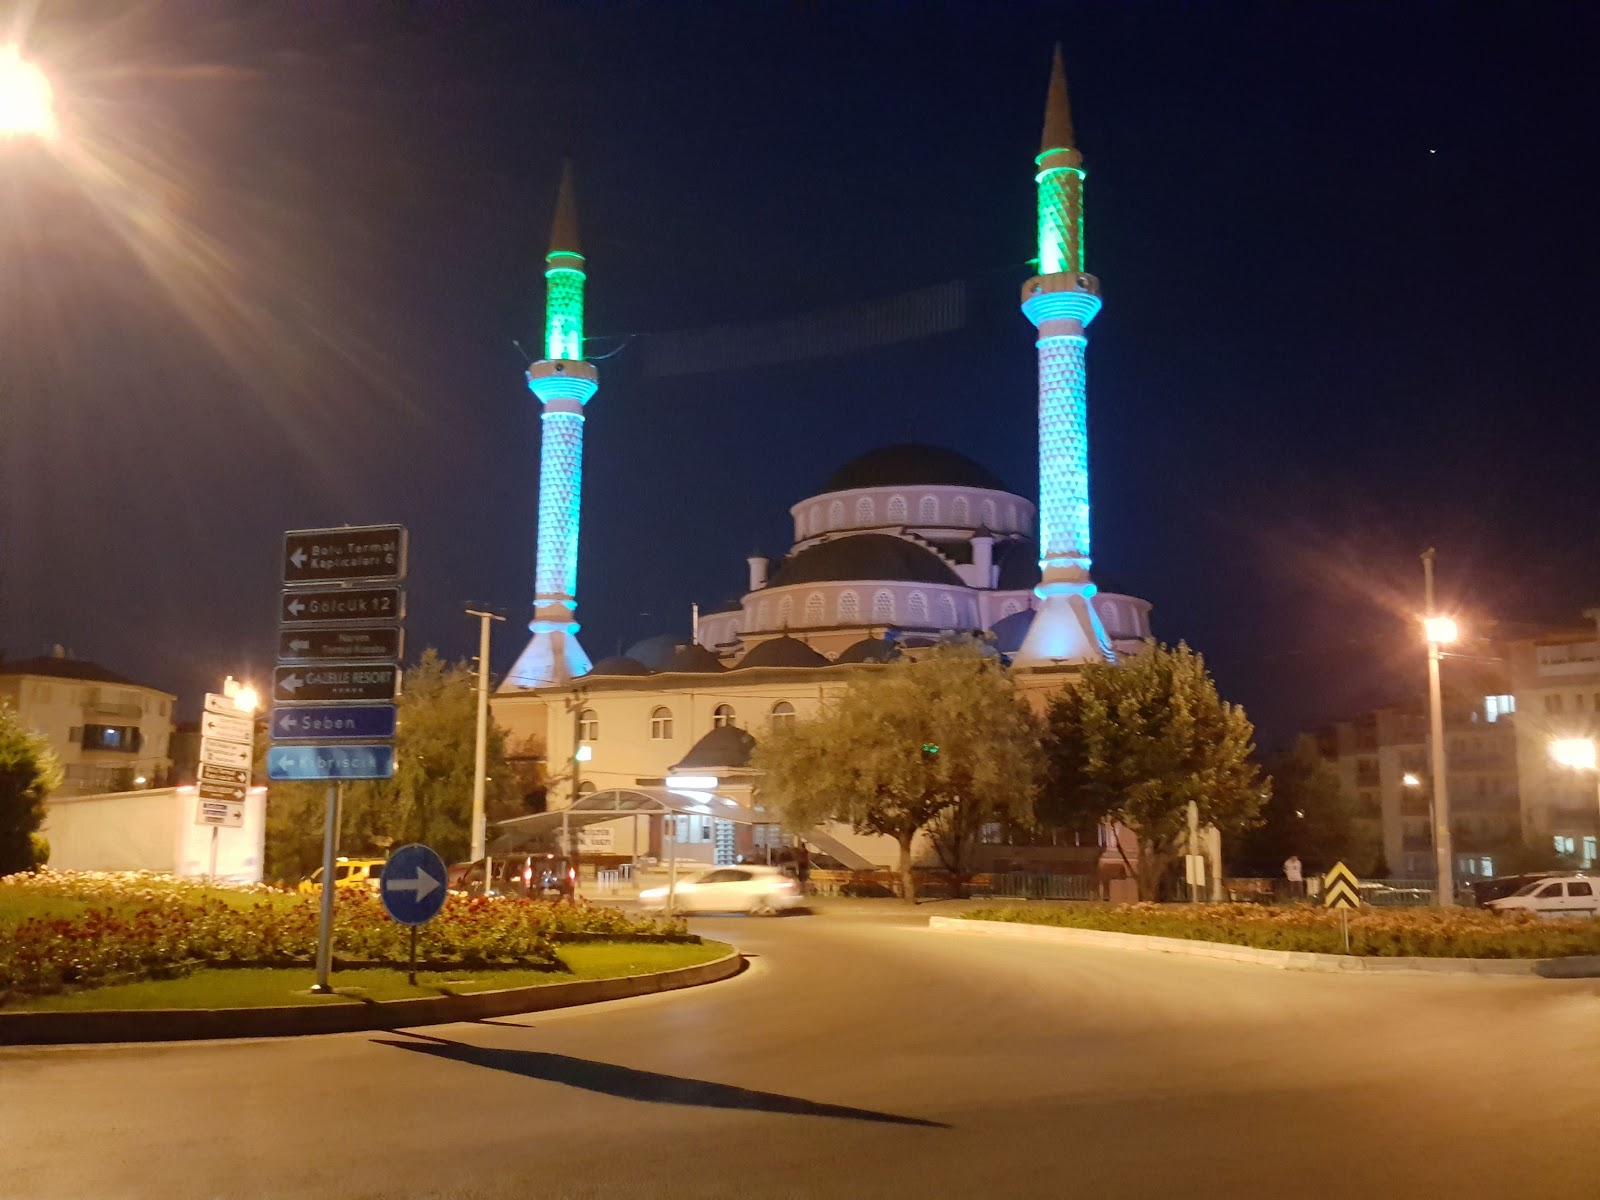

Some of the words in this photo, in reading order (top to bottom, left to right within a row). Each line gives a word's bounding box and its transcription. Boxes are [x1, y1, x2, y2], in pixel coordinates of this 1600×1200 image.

[347, 542, 394, 553] Termal
[371, 597, 391, 611] 12
[301, 716, 356, 730] Seben
